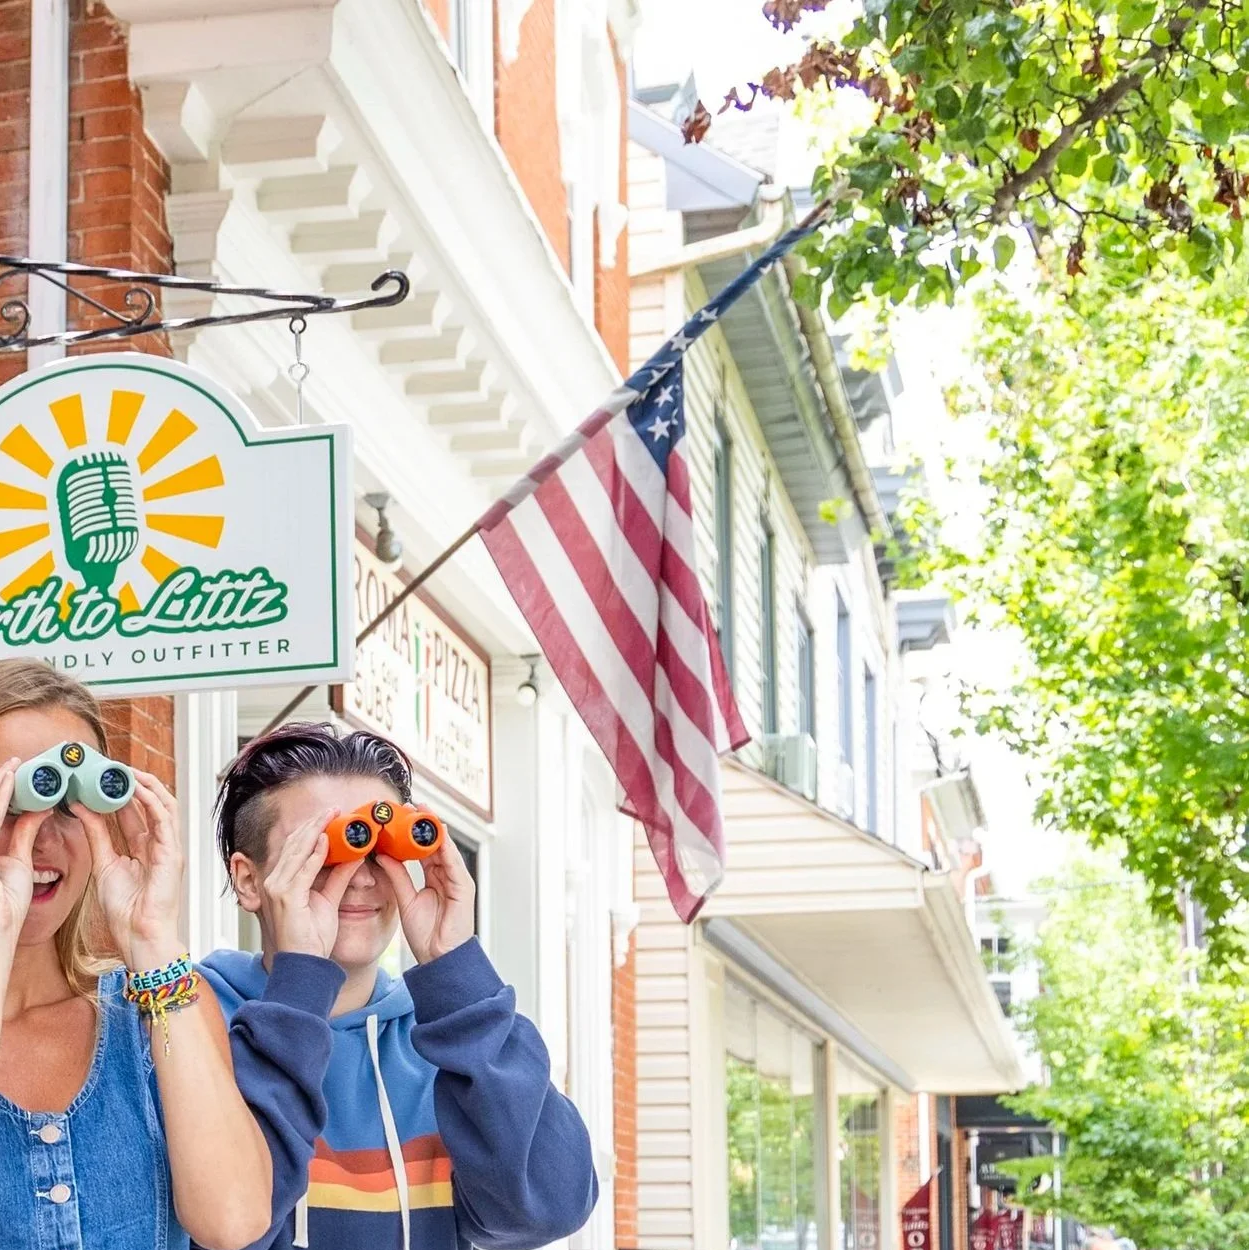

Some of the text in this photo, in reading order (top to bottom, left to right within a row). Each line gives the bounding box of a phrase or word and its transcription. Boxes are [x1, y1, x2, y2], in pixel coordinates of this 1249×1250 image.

[68, 587, 112, 638] to
[118, 567, 286, 631] Lititz
[131, 638, 291, 664] OUTFITTER
[434, 631, 482, 725] PIZZA
[133, 961, 189, 990] RESIST
